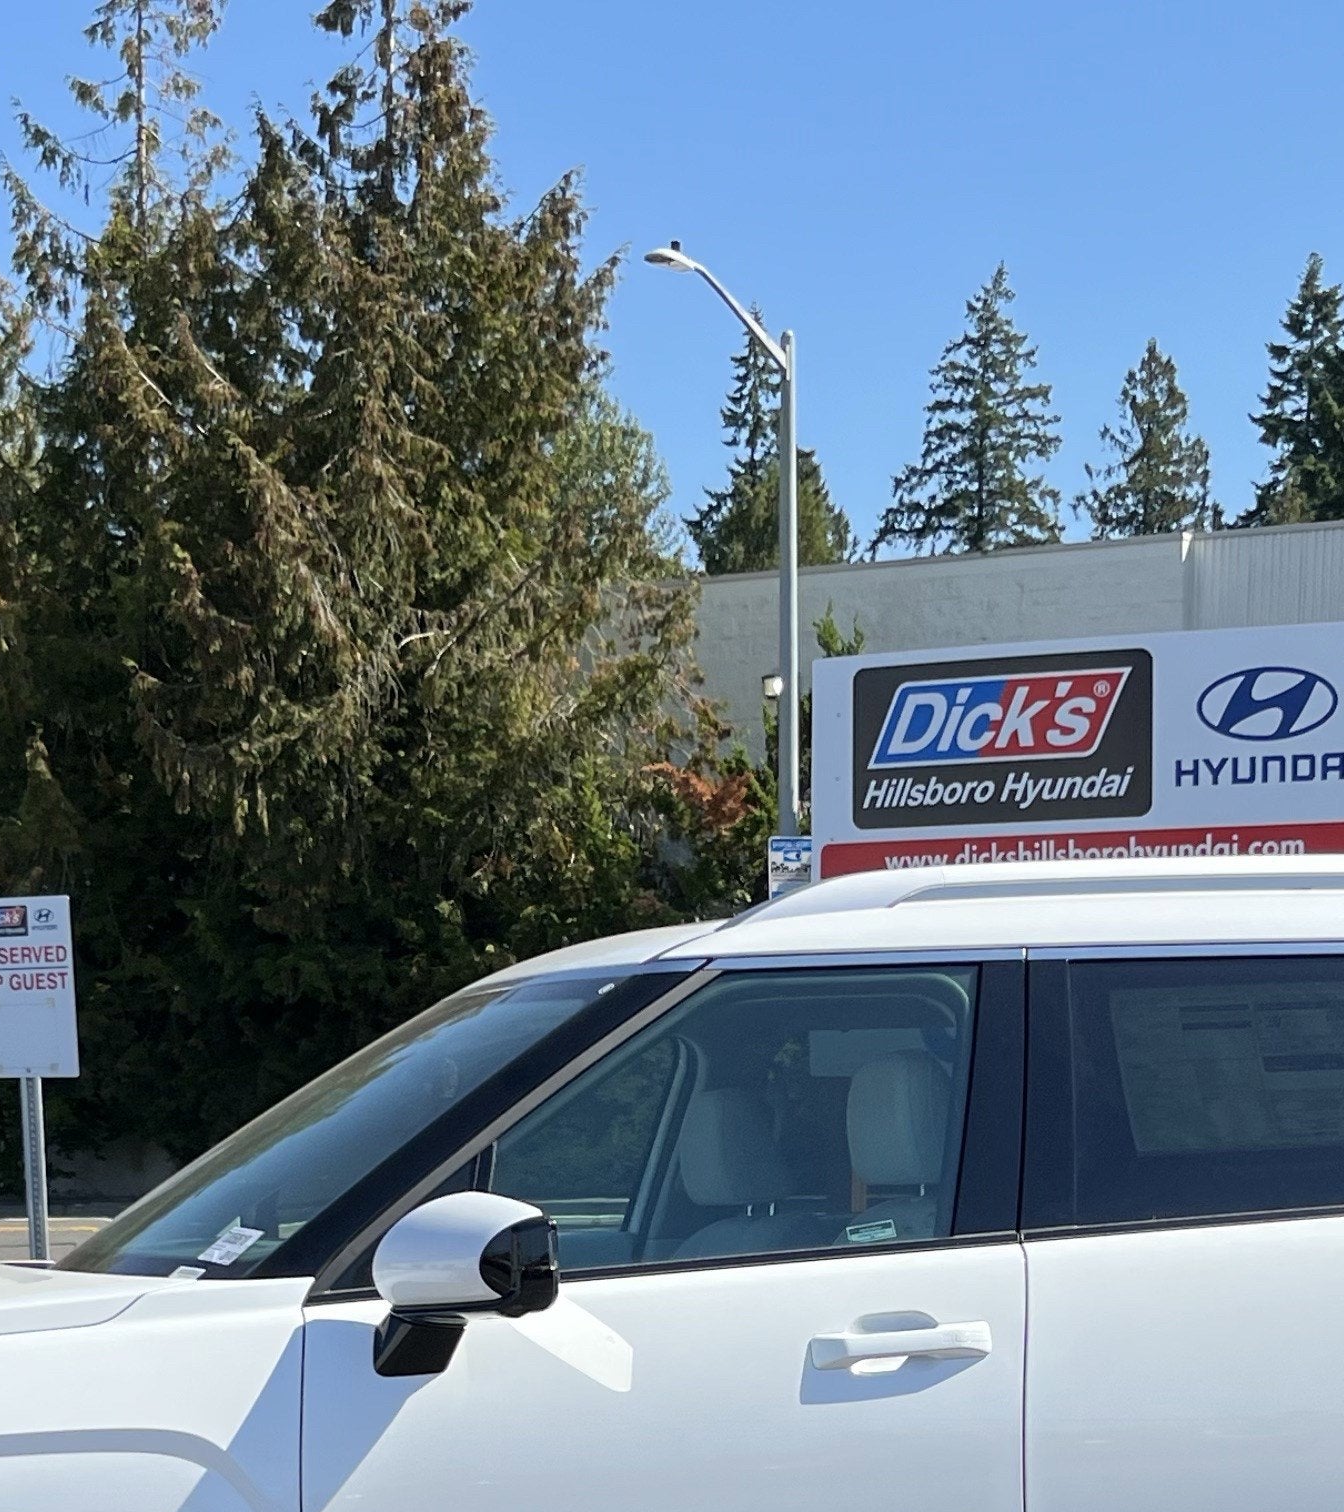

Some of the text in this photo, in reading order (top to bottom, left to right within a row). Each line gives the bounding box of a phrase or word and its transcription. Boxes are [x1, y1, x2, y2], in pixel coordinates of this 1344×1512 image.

[887, 681, 1097, 756] Dick's
[862, 765, 1136, 810] Hillsboro Hyundai
[9, 972, 68, 991] GUEST
